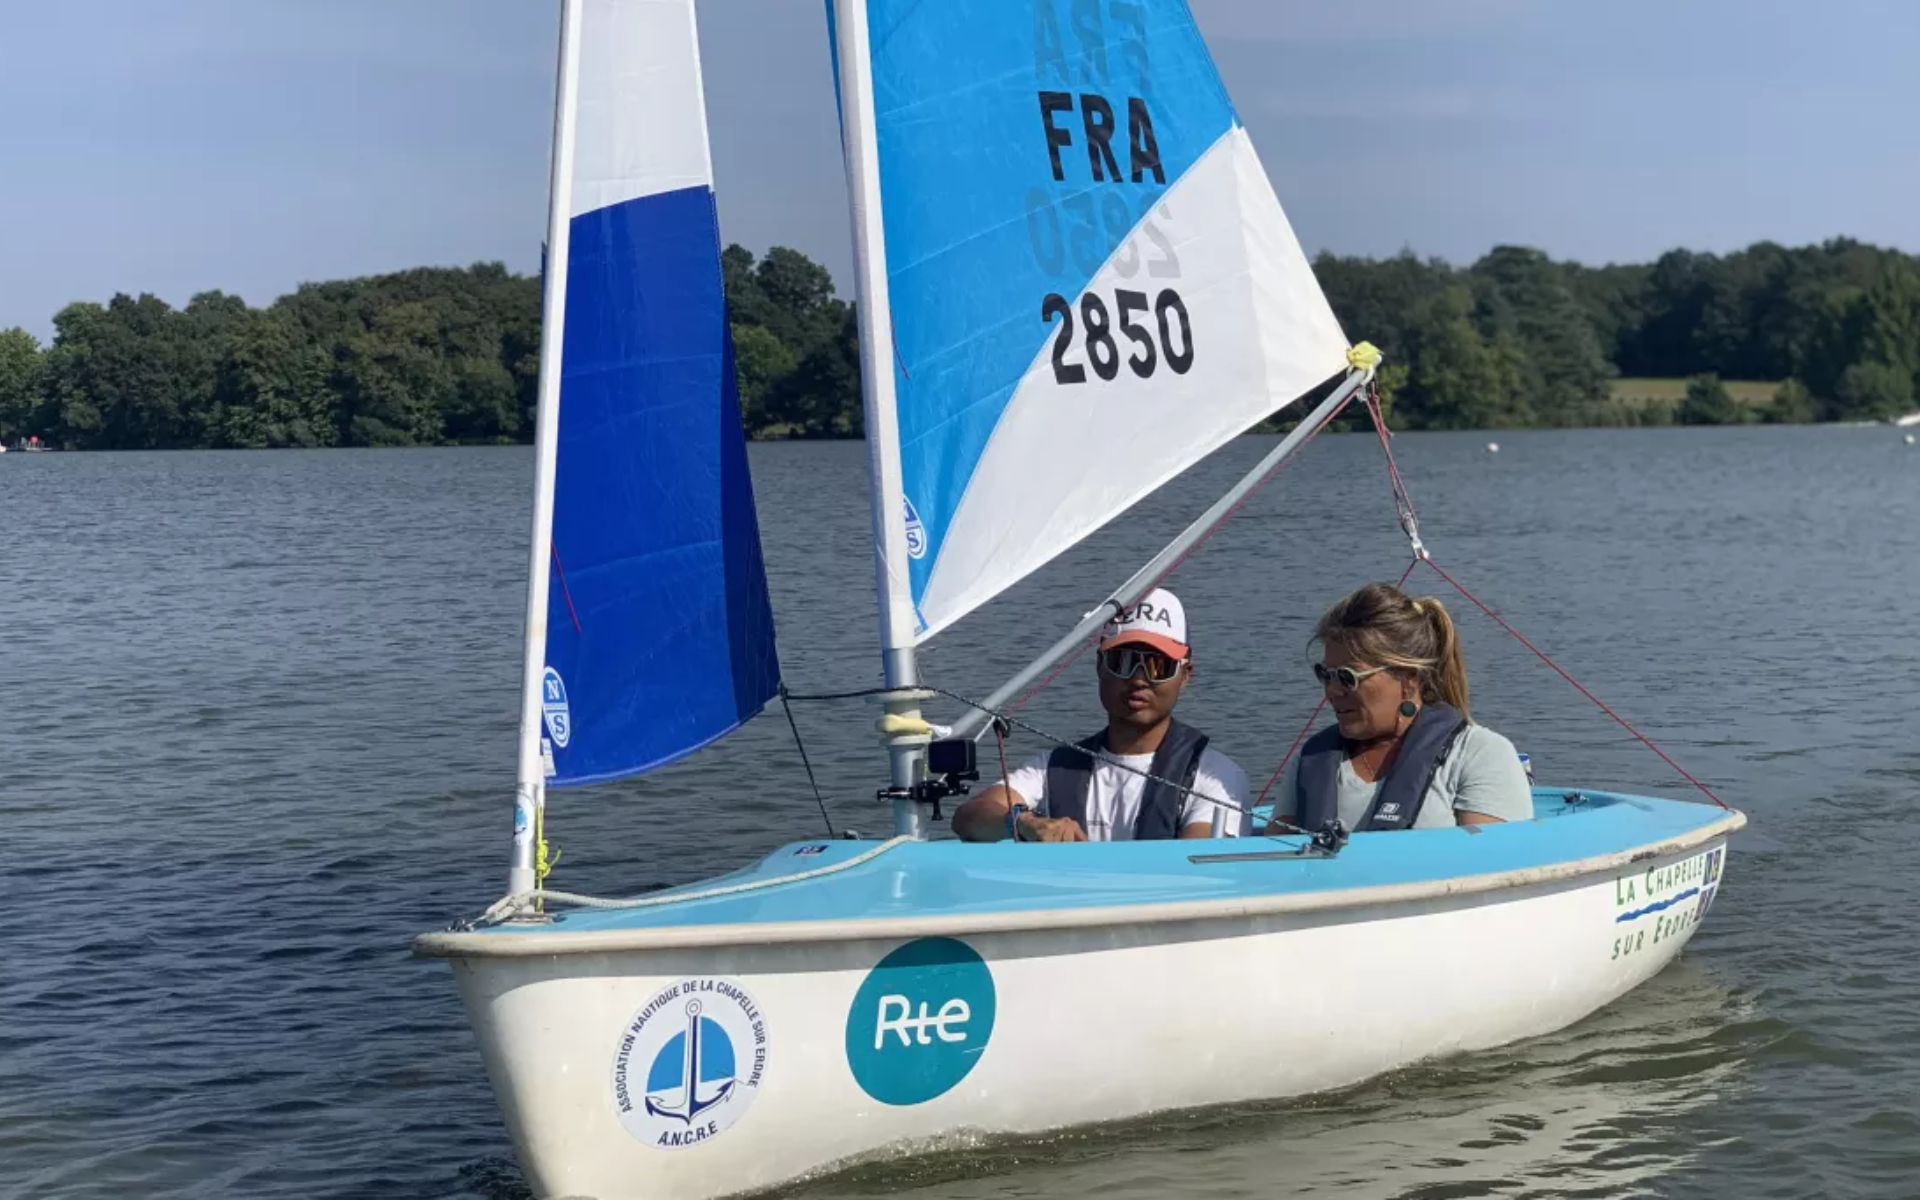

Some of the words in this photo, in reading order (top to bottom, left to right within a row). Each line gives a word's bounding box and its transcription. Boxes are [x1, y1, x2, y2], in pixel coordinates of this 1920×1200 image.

[1038, 91, 1166, 184] FRA
[1042, 288, 1194, 384] 2850
[546, 680, 560, 699] N
[554, 715, 565, 734] S
[1616, 876, 1635, 905] LA
[1645, 855, 1703, 896] CHAPELLE
[1611, 930, 1644, 960] SUR
[683, 980, 697, 994] DE
[700, 979, 713, 991] LA
[717, 981, 759, 1022] CHAPELLE
[631, 986, 680, 1034] NAUTIQUE
[874, 994, 971, 1050] Rte
[752, 1020, 765, 1045] SUR
[615, 1034, 636, 1113] ASSOCIATION
[748, 1048, 766, 1088] ERDRE
